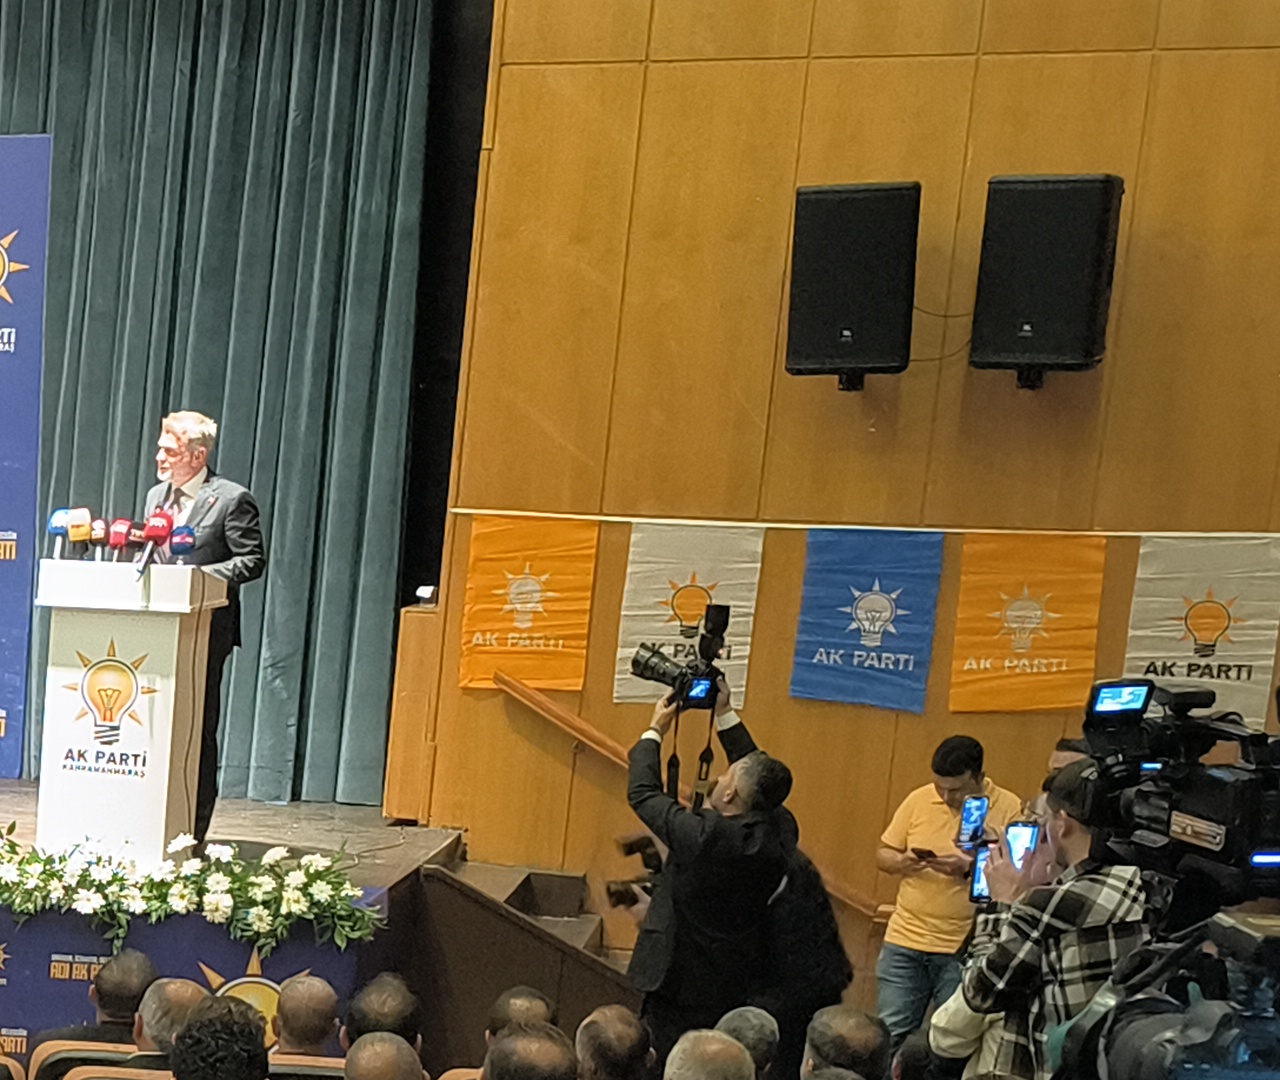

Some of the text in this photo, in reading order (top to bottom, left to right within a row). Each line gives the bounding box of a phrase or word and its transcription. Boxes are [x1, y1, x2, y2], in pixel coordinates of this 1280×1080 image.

[471, 632, 498, 648] AK
[812, 648, 845, 665] AK
[963, 657, 992, 671] AK
[1144, 661, 1176, 678] AK
[64, 748, 88, 762] AK
